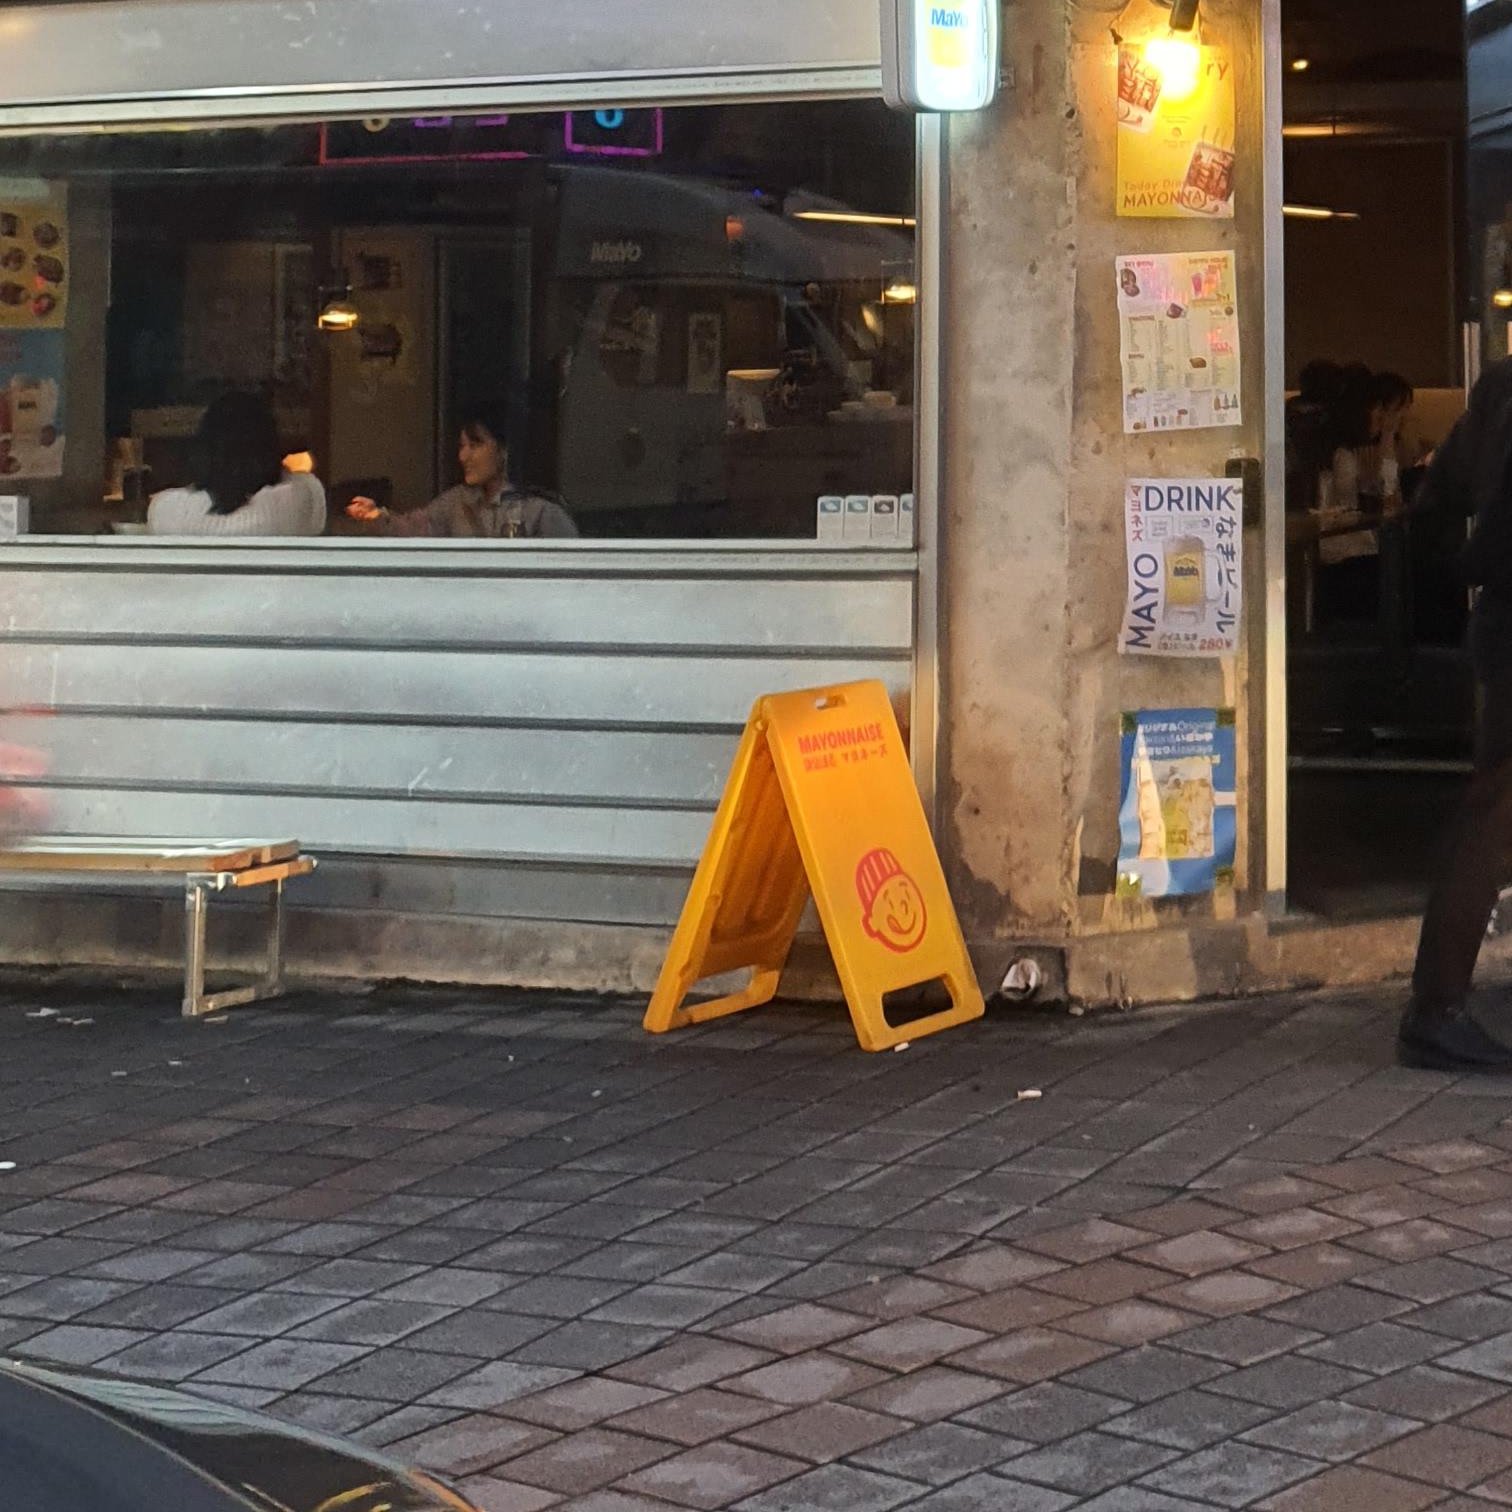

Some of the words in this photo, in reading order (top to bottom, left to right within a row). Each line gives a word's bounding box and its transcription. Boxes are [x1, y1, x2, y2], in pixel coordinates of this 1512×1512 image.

[1123, 190, 1217, 208] MAYONNA
[1145, 485, 1235, 512] DRINK
[1126, 554, 1159, 648] MAYO
[797, 722, 885, 754] MAYONNAISE
